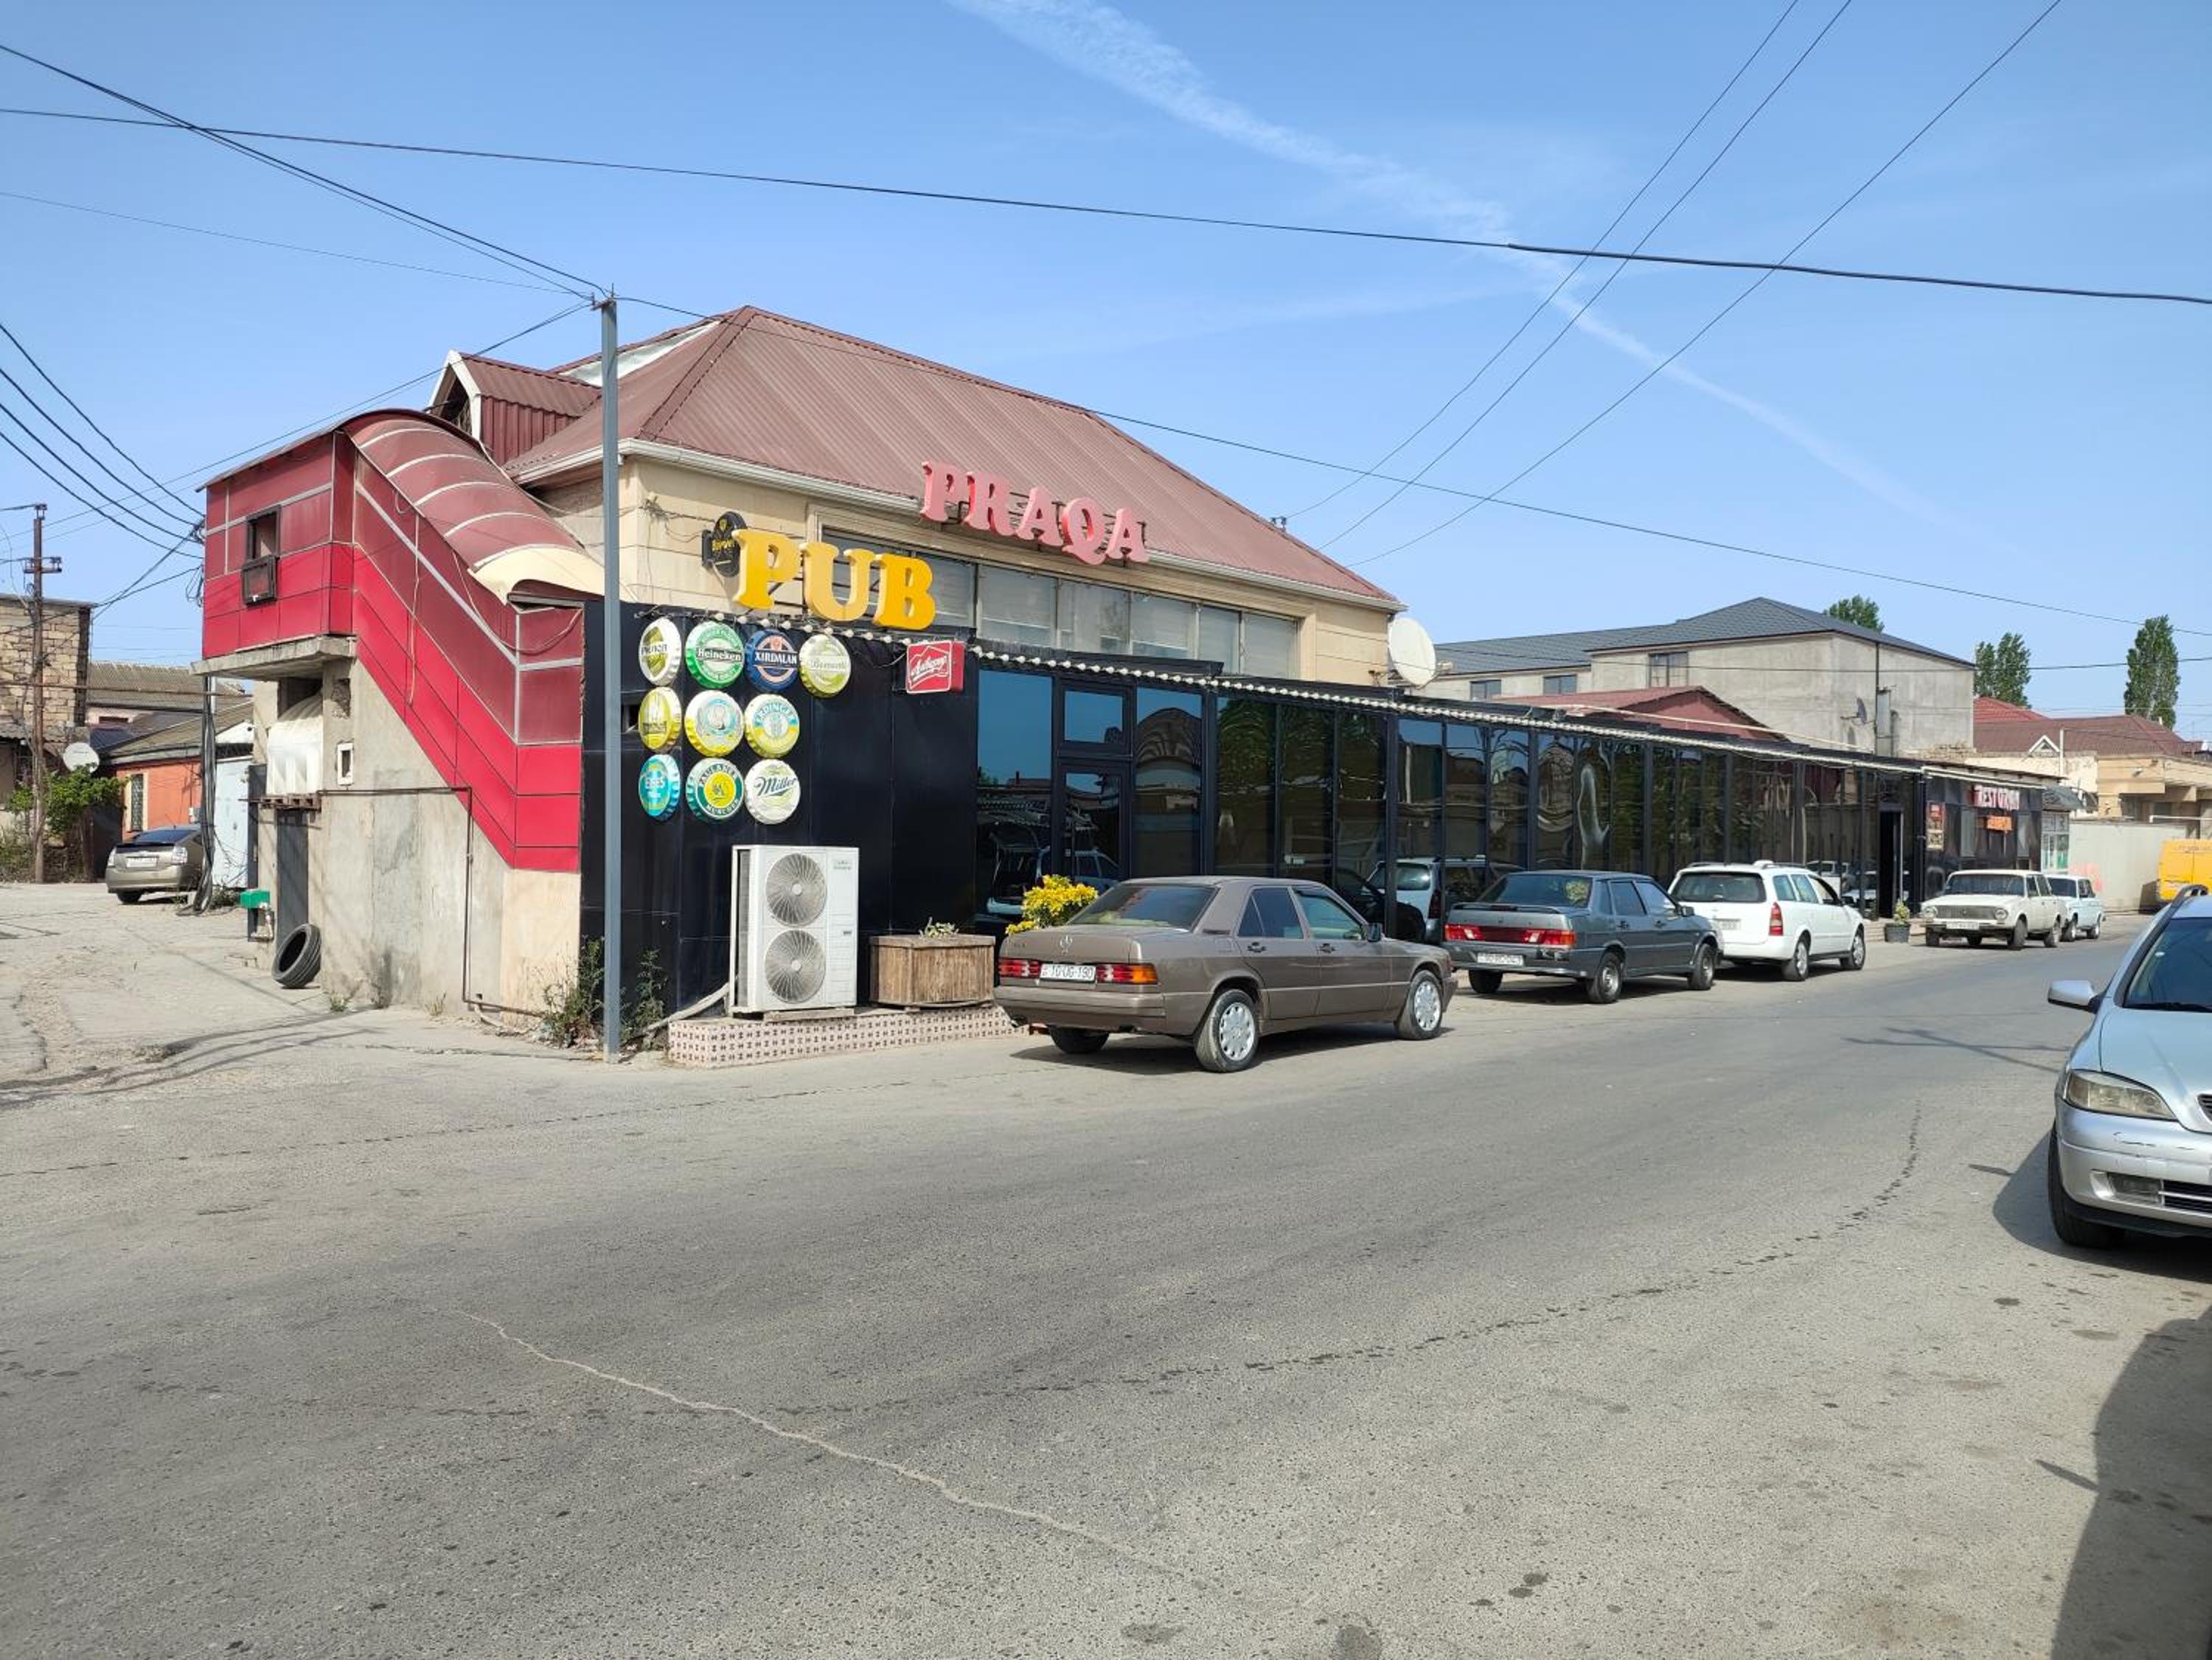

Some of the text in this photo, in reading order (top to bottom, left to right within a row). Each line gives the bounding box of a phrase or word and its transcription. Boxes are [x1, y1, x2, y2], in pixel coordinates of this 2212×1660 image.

[920, 460, 1150, 566] PRAQA
[731, 529, 936, 630] PUB
[697, 648, 741, 661] Heineken
[755, 652, 798, 664] XIRDALAN
[754, 776, 798, 796] Miller
